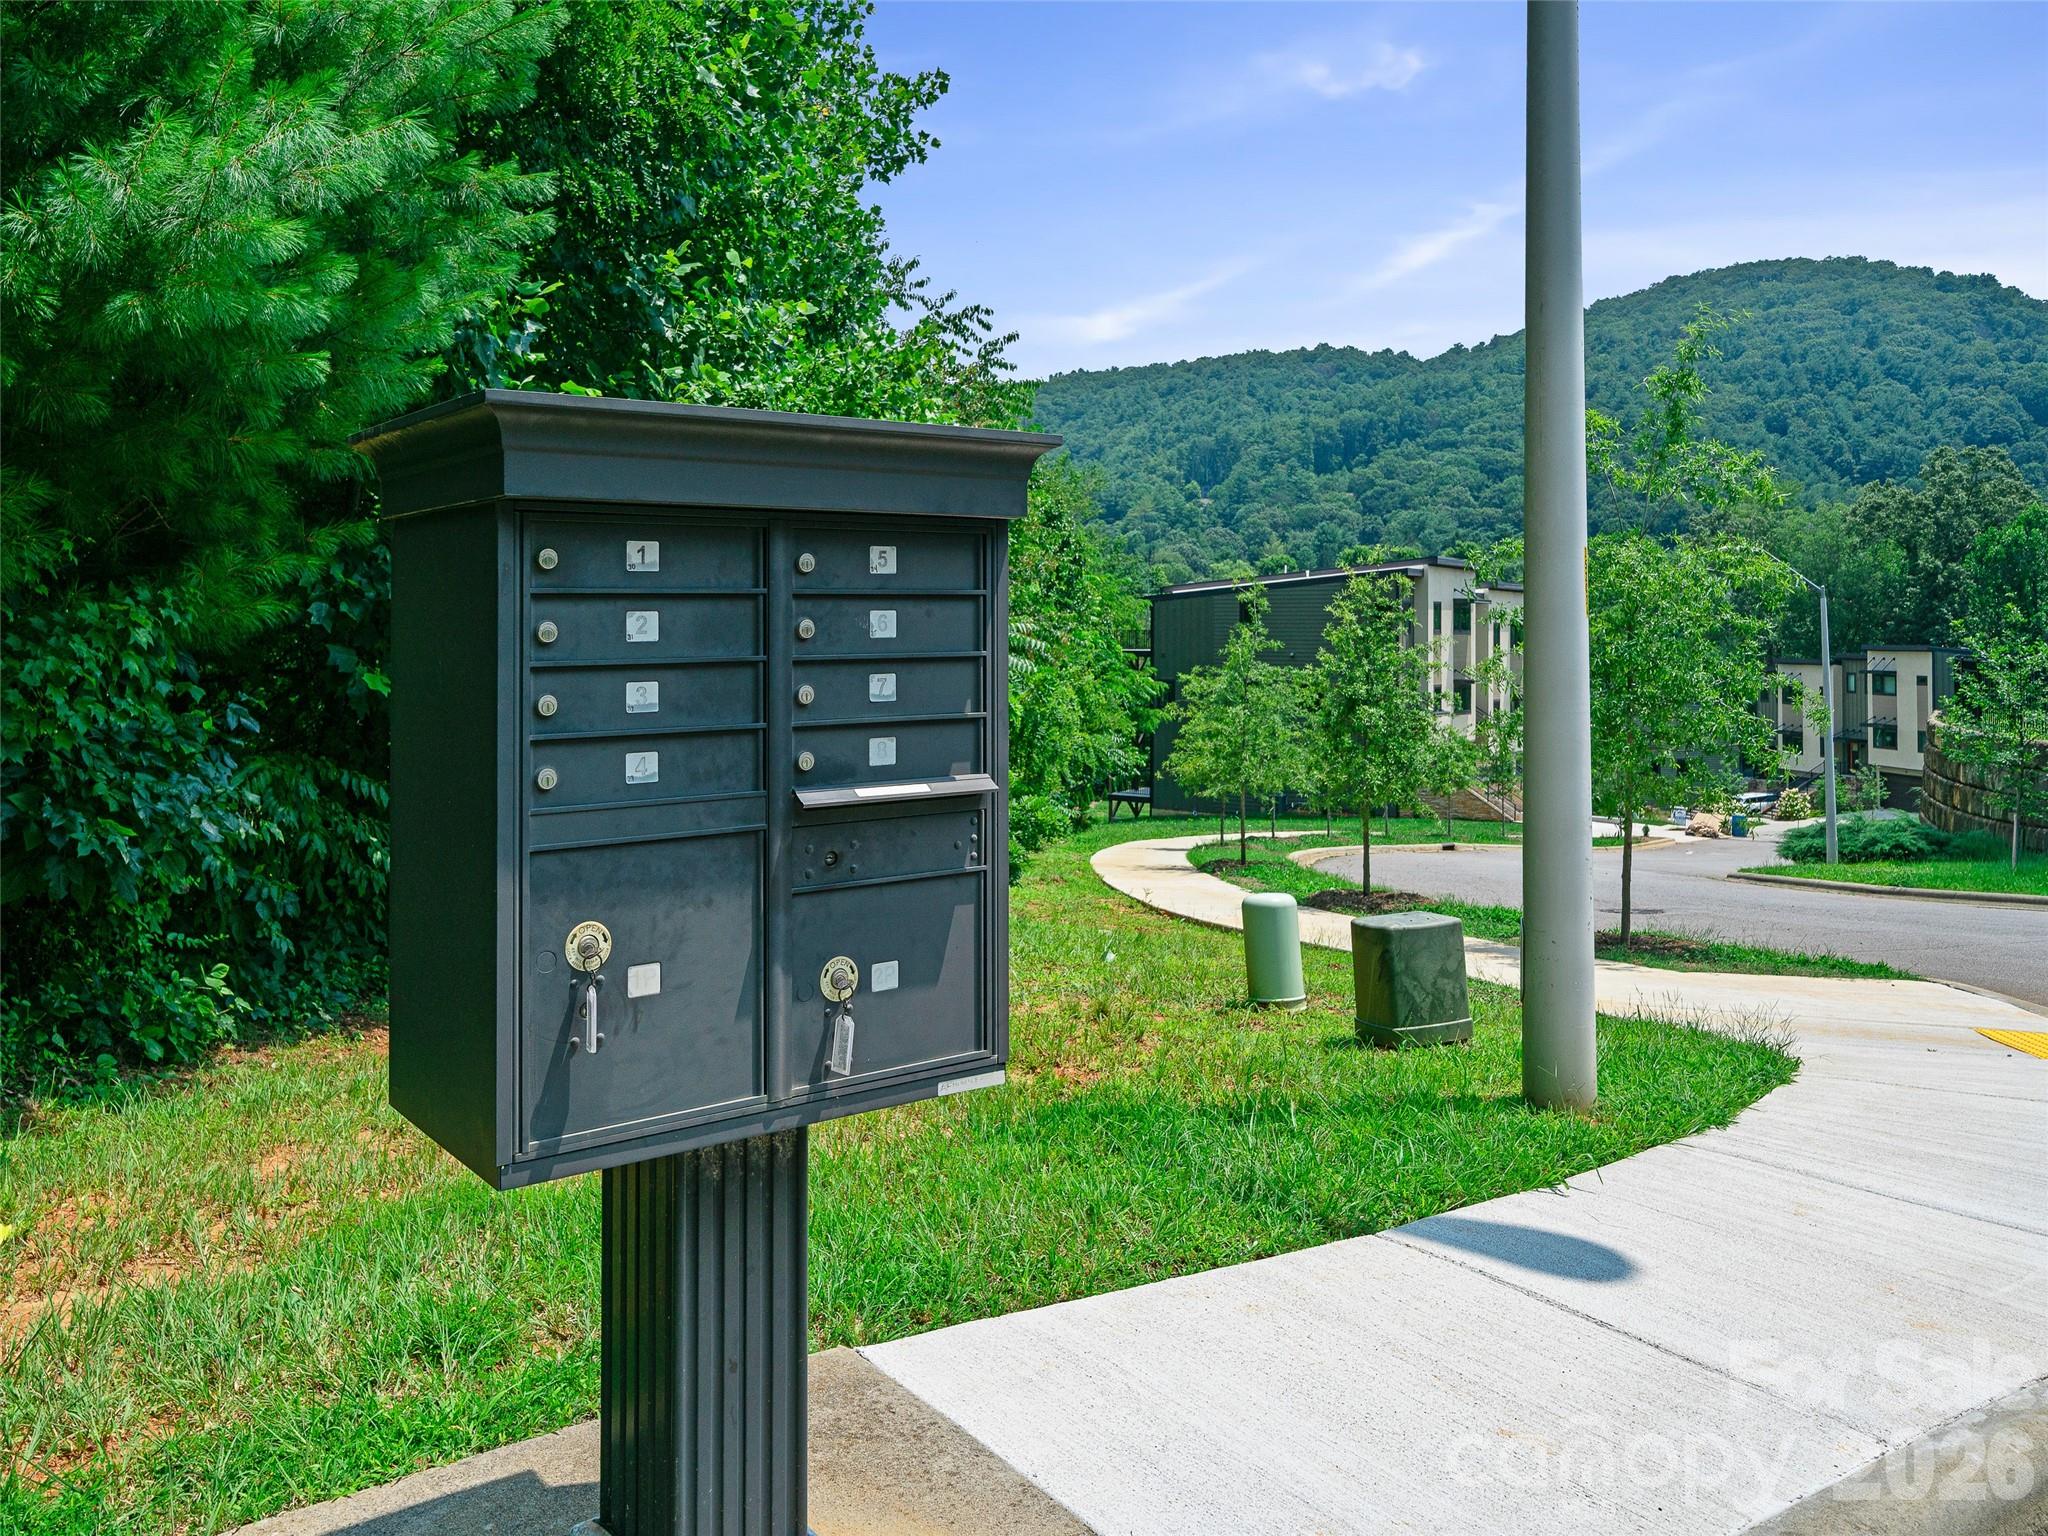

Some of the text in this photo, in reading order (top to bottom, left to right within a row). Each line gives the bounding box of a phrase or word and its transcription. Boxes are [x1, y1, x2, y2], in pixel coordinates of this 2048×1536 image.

[636, 545, 646, 565] 1
[877, 550, 888, 568] 5
[635, 615, 648, 635] 2
[877, 614, 888, 632] 6
[635, 686, 648, 705] 3
[876, 677, 887, 697] 7
[877, 741, 887, 759] 8
[634, 756, 648, 775] 4
[578, 924, 603, 935] OPEN
[829, 958, 850, 969] OPEN
